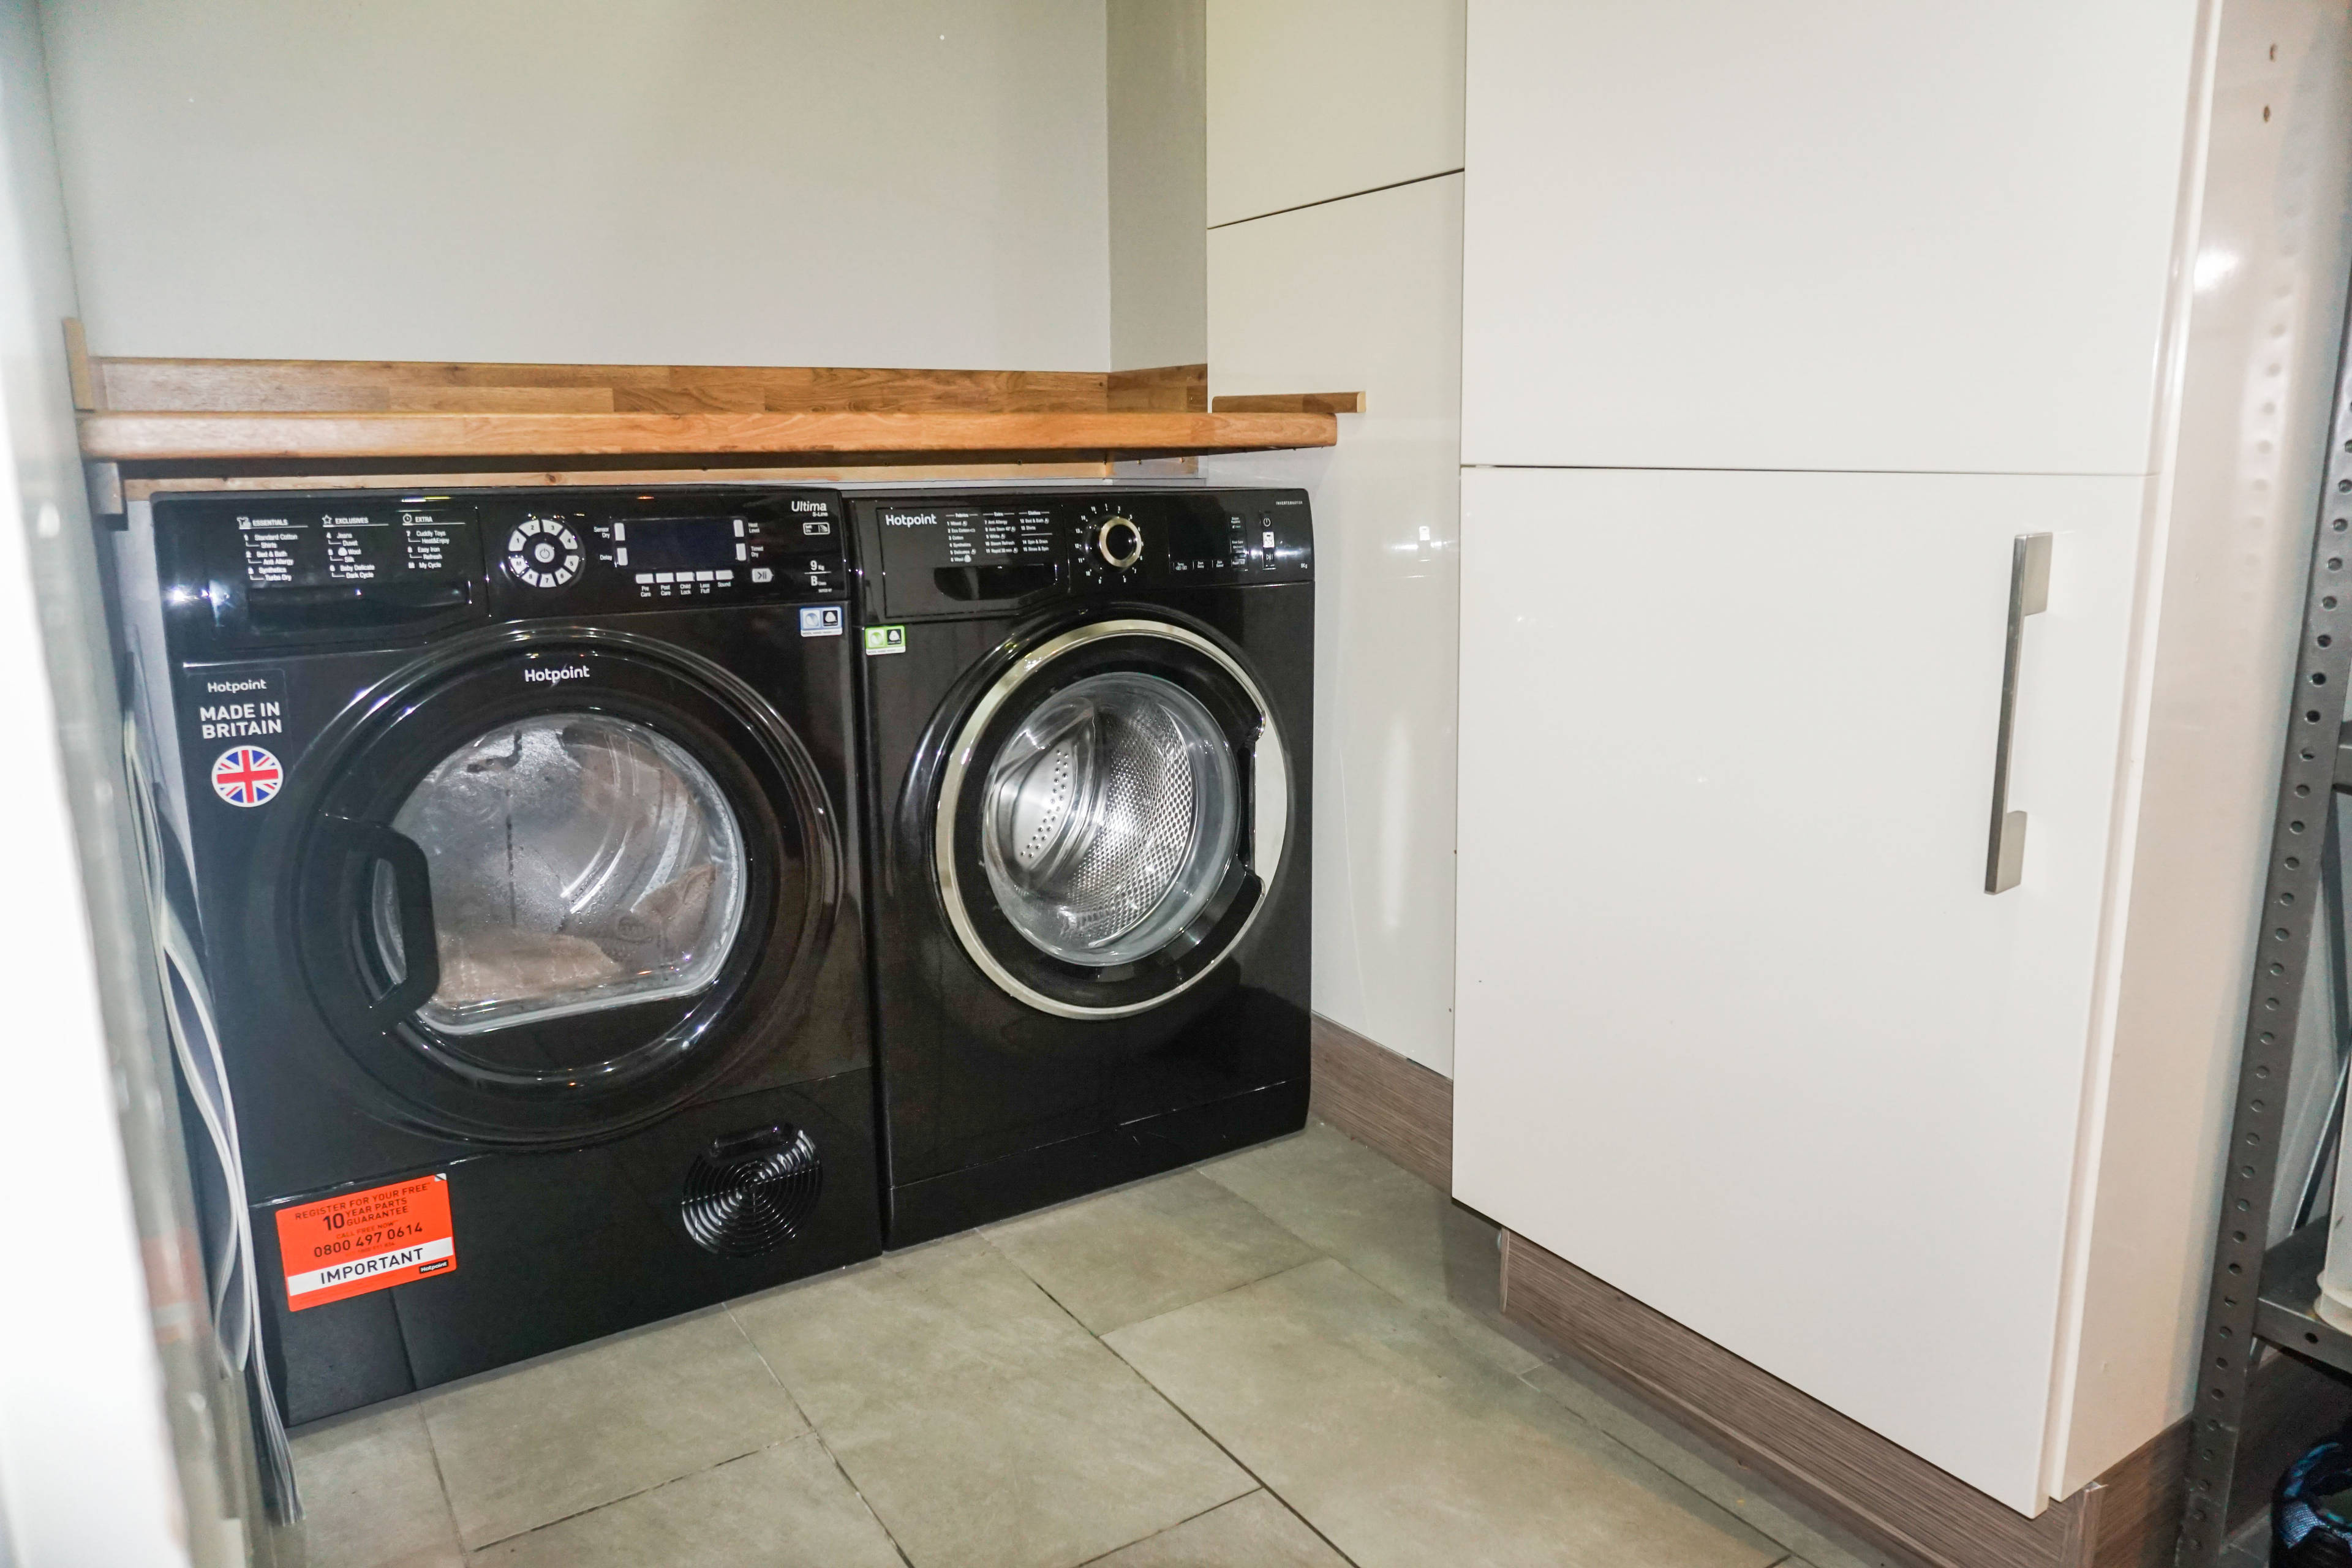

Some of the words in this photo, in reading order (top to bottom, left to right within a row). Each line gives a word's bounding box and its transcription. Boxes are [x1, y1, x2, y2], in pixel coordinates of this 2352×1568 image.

[791, 501, 827, 511] Ultima
[885, 513, 937, 528] Hotpoint
[810, 560, 817, 571] 9
[811, 576, 818, 586] B
[525, 665, 590, 683] Hotpoint
[208, 679, 267, 693] Hotpoint
[200, 704, 256, 722] MADE
[260, 701, 281, 717] IN
[202, 718, 282, 739] BRITAIN
[295, 1202, 346, 1221] REGISTER
[350, 1197, 369, 1208] FOR
[372, 1189, 399, 1203] YOUR
[323, 1212, 345, 1231] 10
[345, 1205, 372, 1218] YEAR
[375, 1197, 408, 1210] PARTS
[347, 1205, 409, 1226] GUARANTEE
[314, 1239, 351, 1257] 0800
[355, 1231, 382, 1247] 497
[387, 1222, 423, 1240] 0614
[337, 1230, 355, 1239] CALL
[356, 1225, 376, 1234] FREE
[321, 1248, 424, 1284] IMPORTANT
[420, 1261, 448, 1273] Hotpoint
